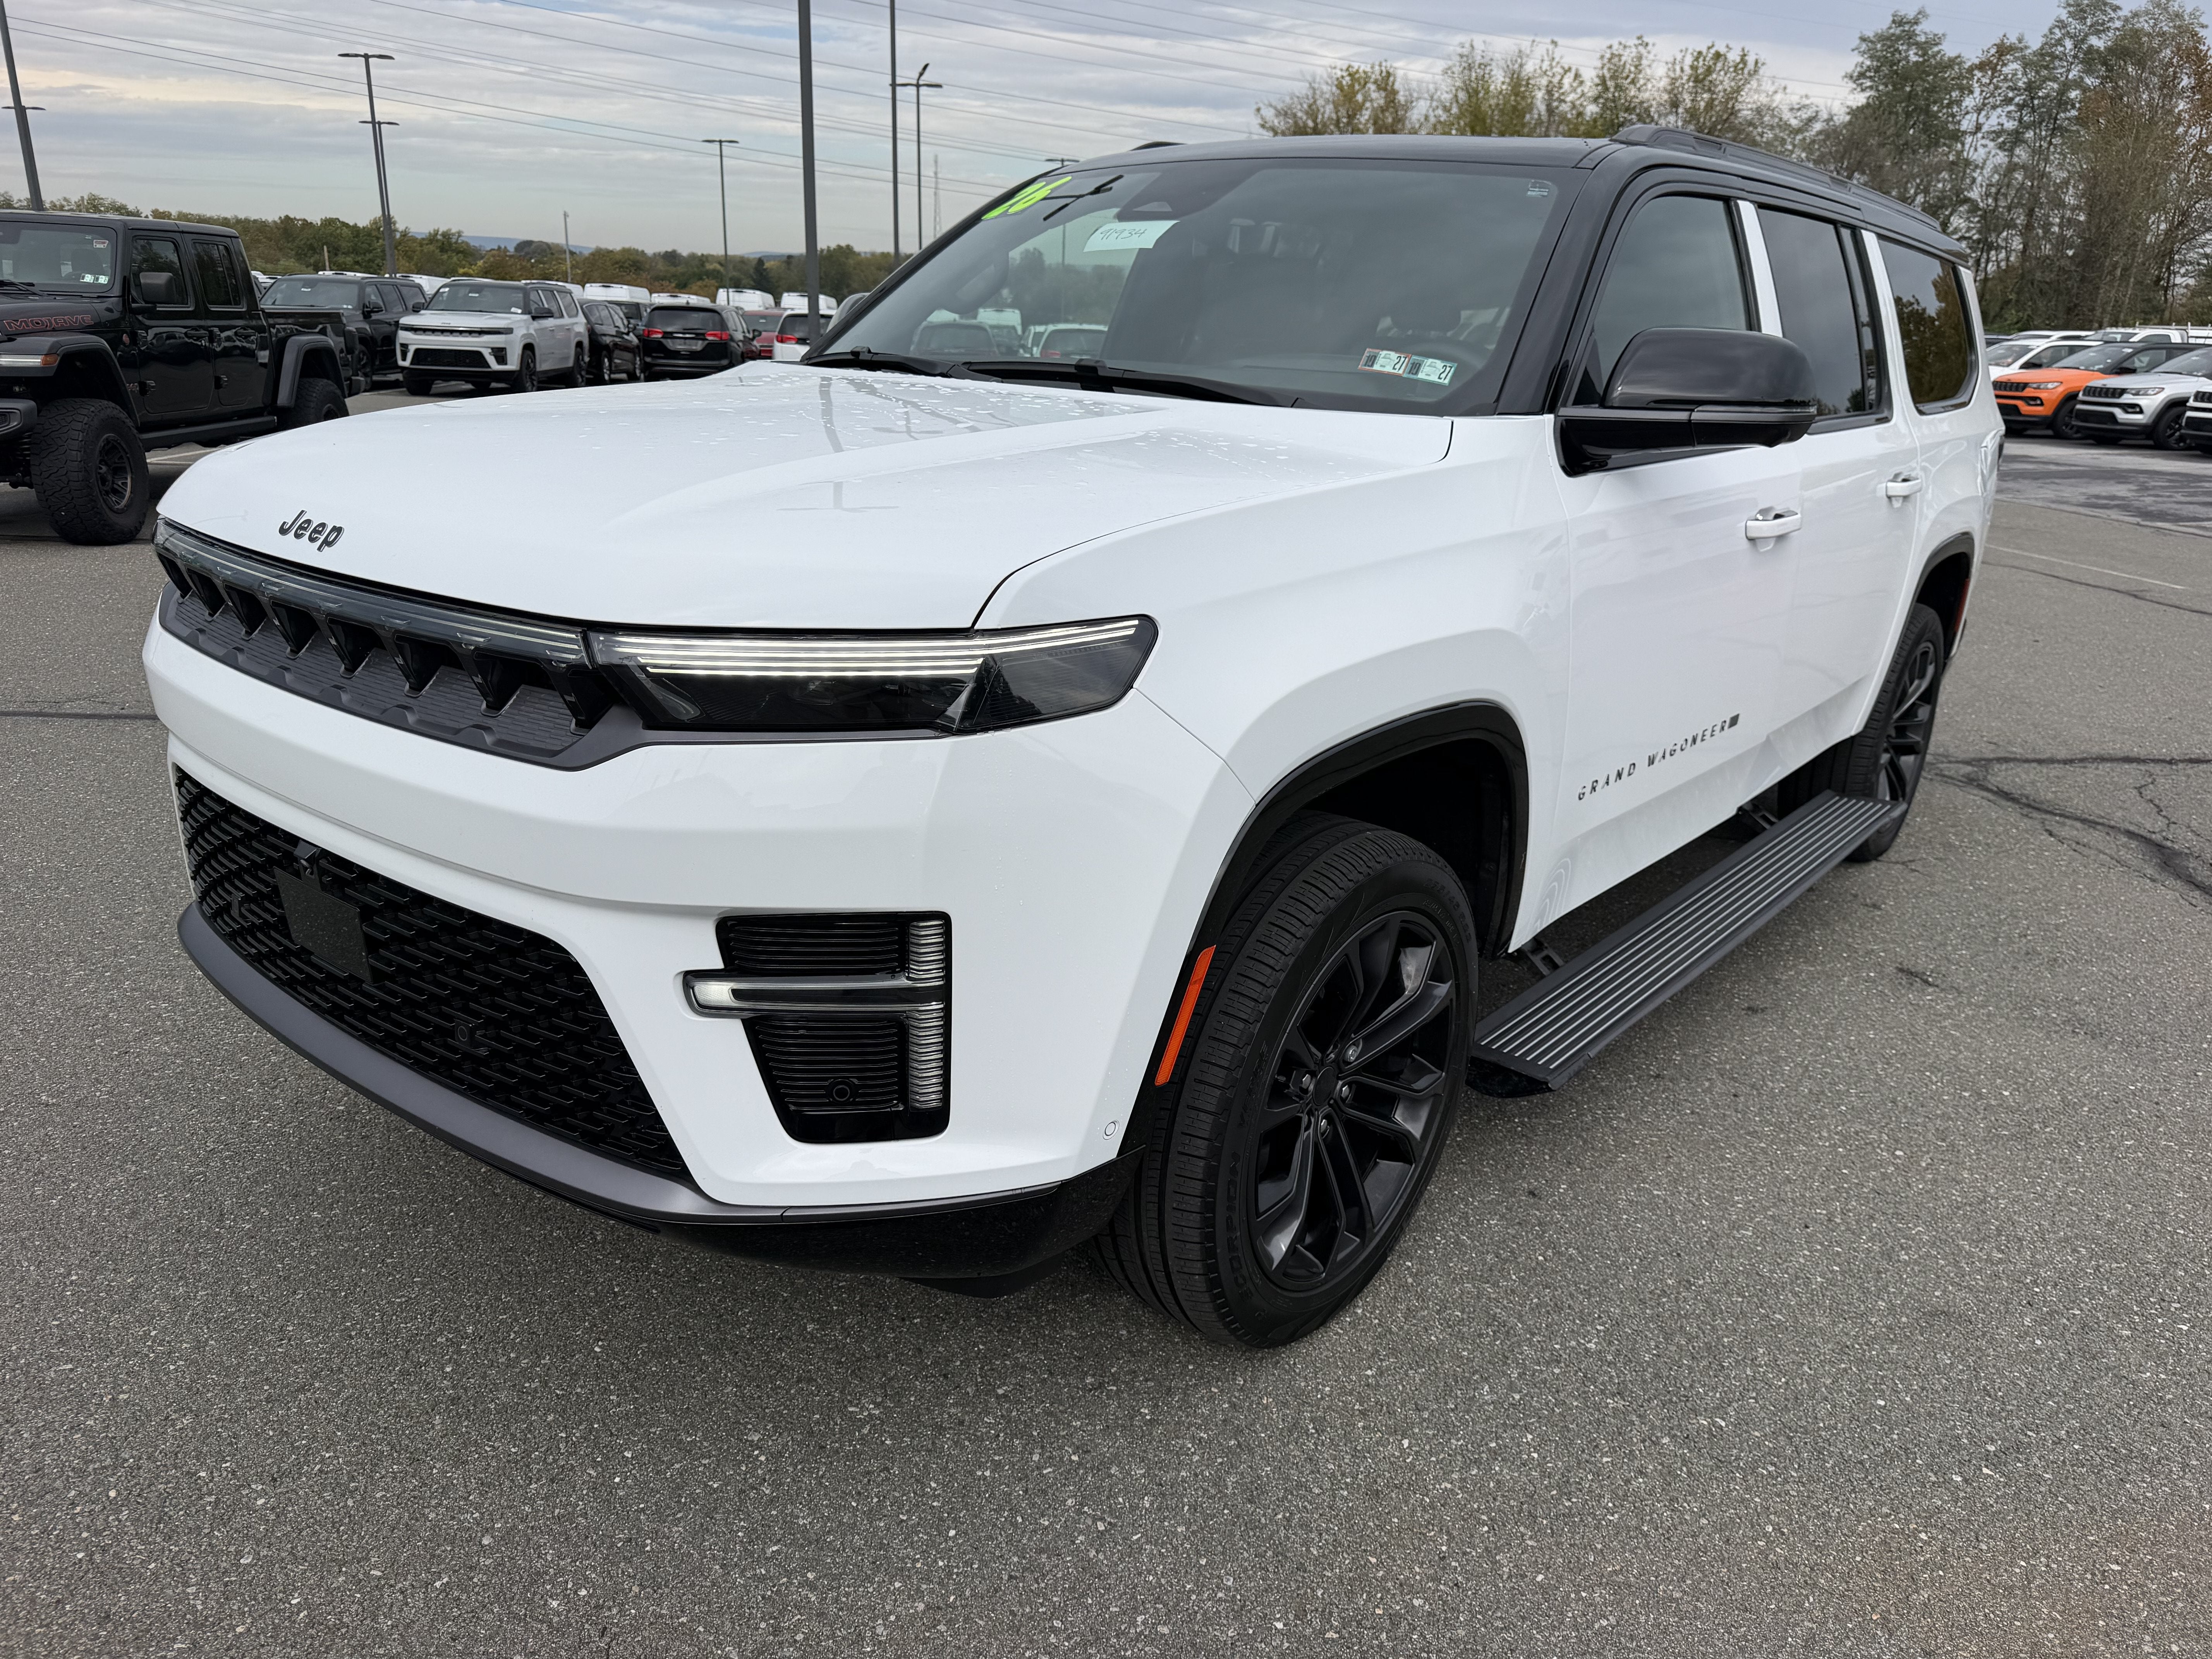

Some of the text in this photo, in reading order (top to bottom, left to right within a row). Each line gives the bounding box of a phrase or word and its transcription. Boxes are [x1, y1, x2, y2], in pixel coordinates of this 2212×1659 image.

[981, 176, 1072, 220] 26
[1100, 228, 1147, 240] 91934
[3, 314, 94, 331] MOJAVE
[1392, 356, 1407, 371] 27
[1437, 364, 1453, 381] 27
[278, 509, 345, 552] Jeep
[1578, 720, 1727, 801] GRAND WAGONEER
